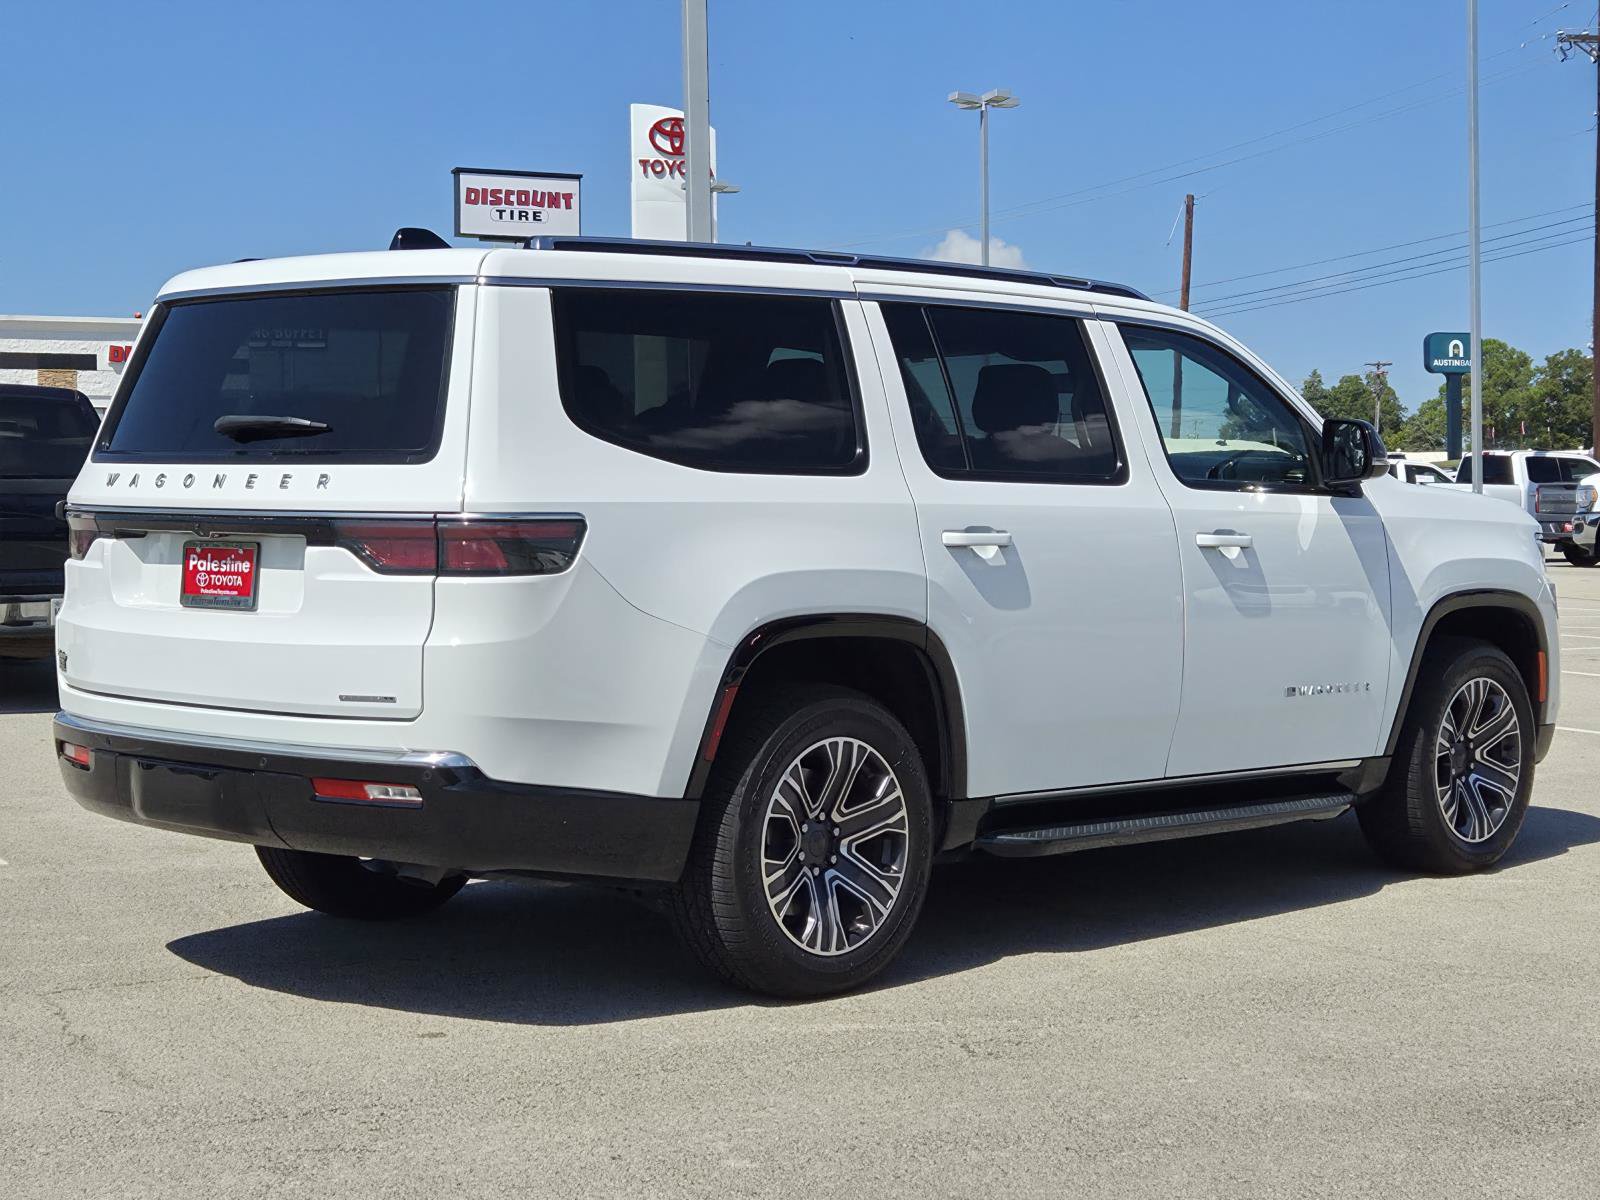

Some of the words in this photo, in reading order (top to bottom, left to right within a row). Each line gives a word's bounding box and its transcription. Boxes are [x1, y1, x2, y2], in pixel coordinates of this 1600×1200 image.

[638, 159, 716, 177] TOYO
[465, 187, 574, 210] DISCOUNT
[495, 209, 543, 222] TIRE
[1433, 359, 1472, 367] AUSTINBA
[106, 472, 332, 490] WAGONEER
[189, 553, 251, 573] Palestine
[209, 574, 243, 587] TOYOTA
